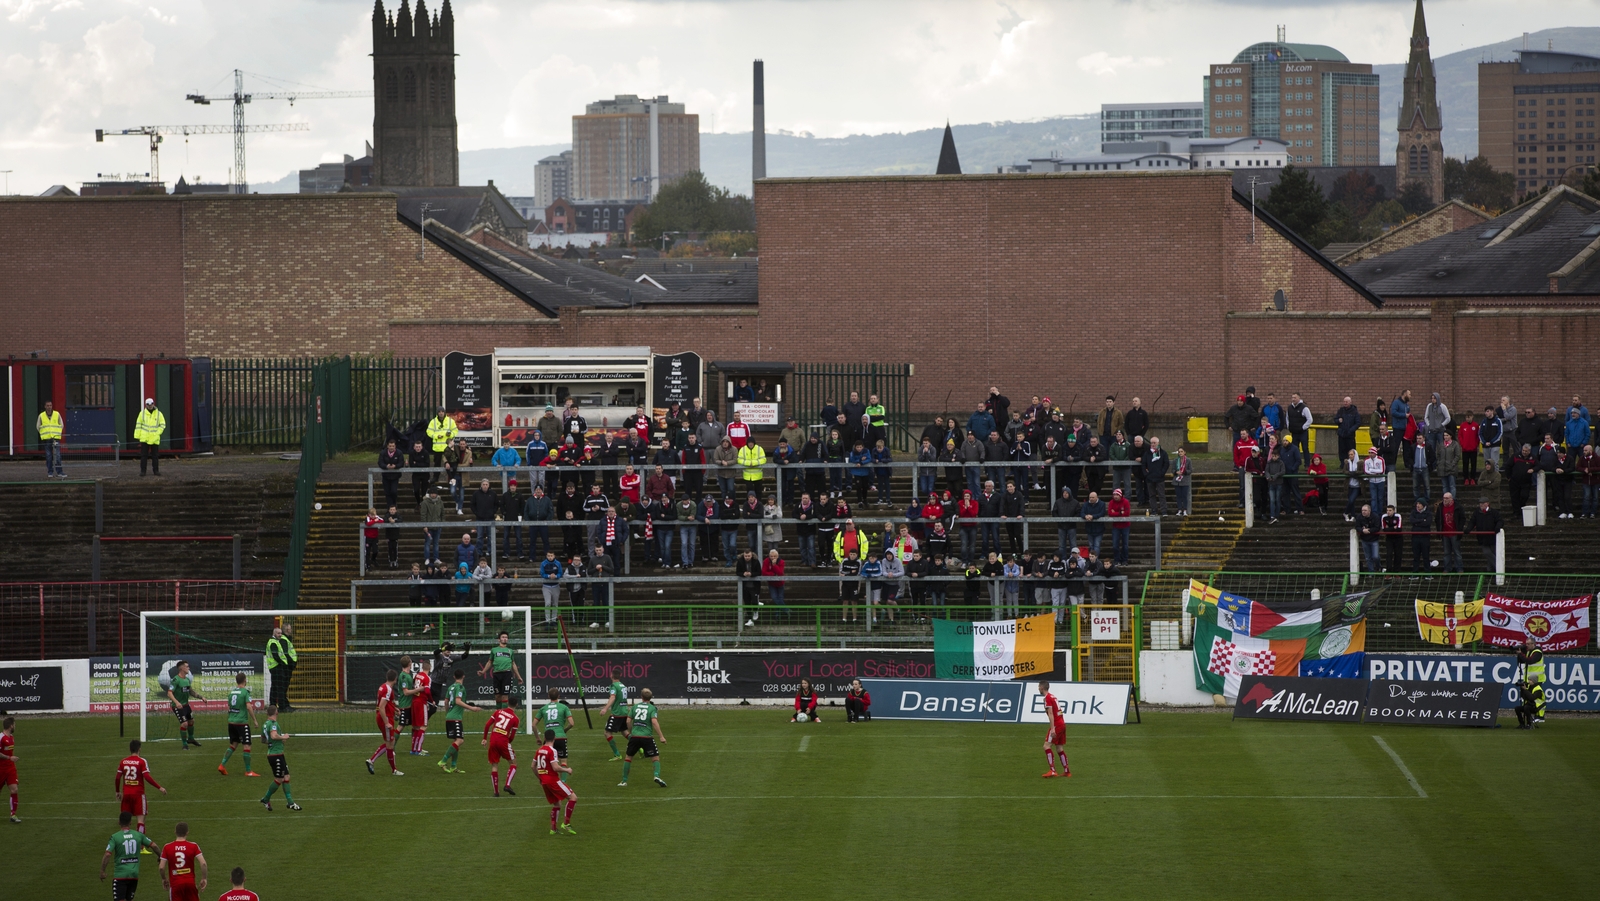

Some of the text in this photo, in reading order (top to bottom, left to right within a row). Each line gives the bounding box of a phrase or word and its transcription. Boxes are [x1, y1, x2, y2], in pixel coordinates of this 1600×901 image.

[1215, 66, 1241, 74] bt.com
[1285, 64, 1312, 72] bt.com
[1489, 595, 1513, 606] LOVE
[956, 622, 1032, 636] CLIFTONVILLE F.C.
[687, 656, 720, 670] reid
[763, 660, 934, 678] Your Local Solicitor
[952, 661, 1036, 676] DERRY SUPPORTERS
[687, 670, 731, 684] black
[1370, 660, 1600, 686] PRIVATE CAUAL
[20, 674, 40, 689] bet?
[762, 684, 778, 692] 028
[478, 686, 495, 694] 028
[1389, 684, 1406, 698] Do
[1408, 690, 1428, 703] you
[1432, 690, 1458, 698] wanna
[1545, 688, 1588, 704] 9066
[232, 695, 237, 706] 8
[900, 690, 1012, 712] Danske
[1256, 689, 1359, 716] A.McLean
[546, 708, 558, 720] 19
[634, 708, 648, 720] 23
[1370, 708, 1492, 719] BOOKMAKERS
[496, 714, 510, 729] 21
[537, 755, 546, 768] 16
[124, 766, 137, 780] 23
[122, 839, 136, 855] 10
[175, 852, 186, 868] 3
